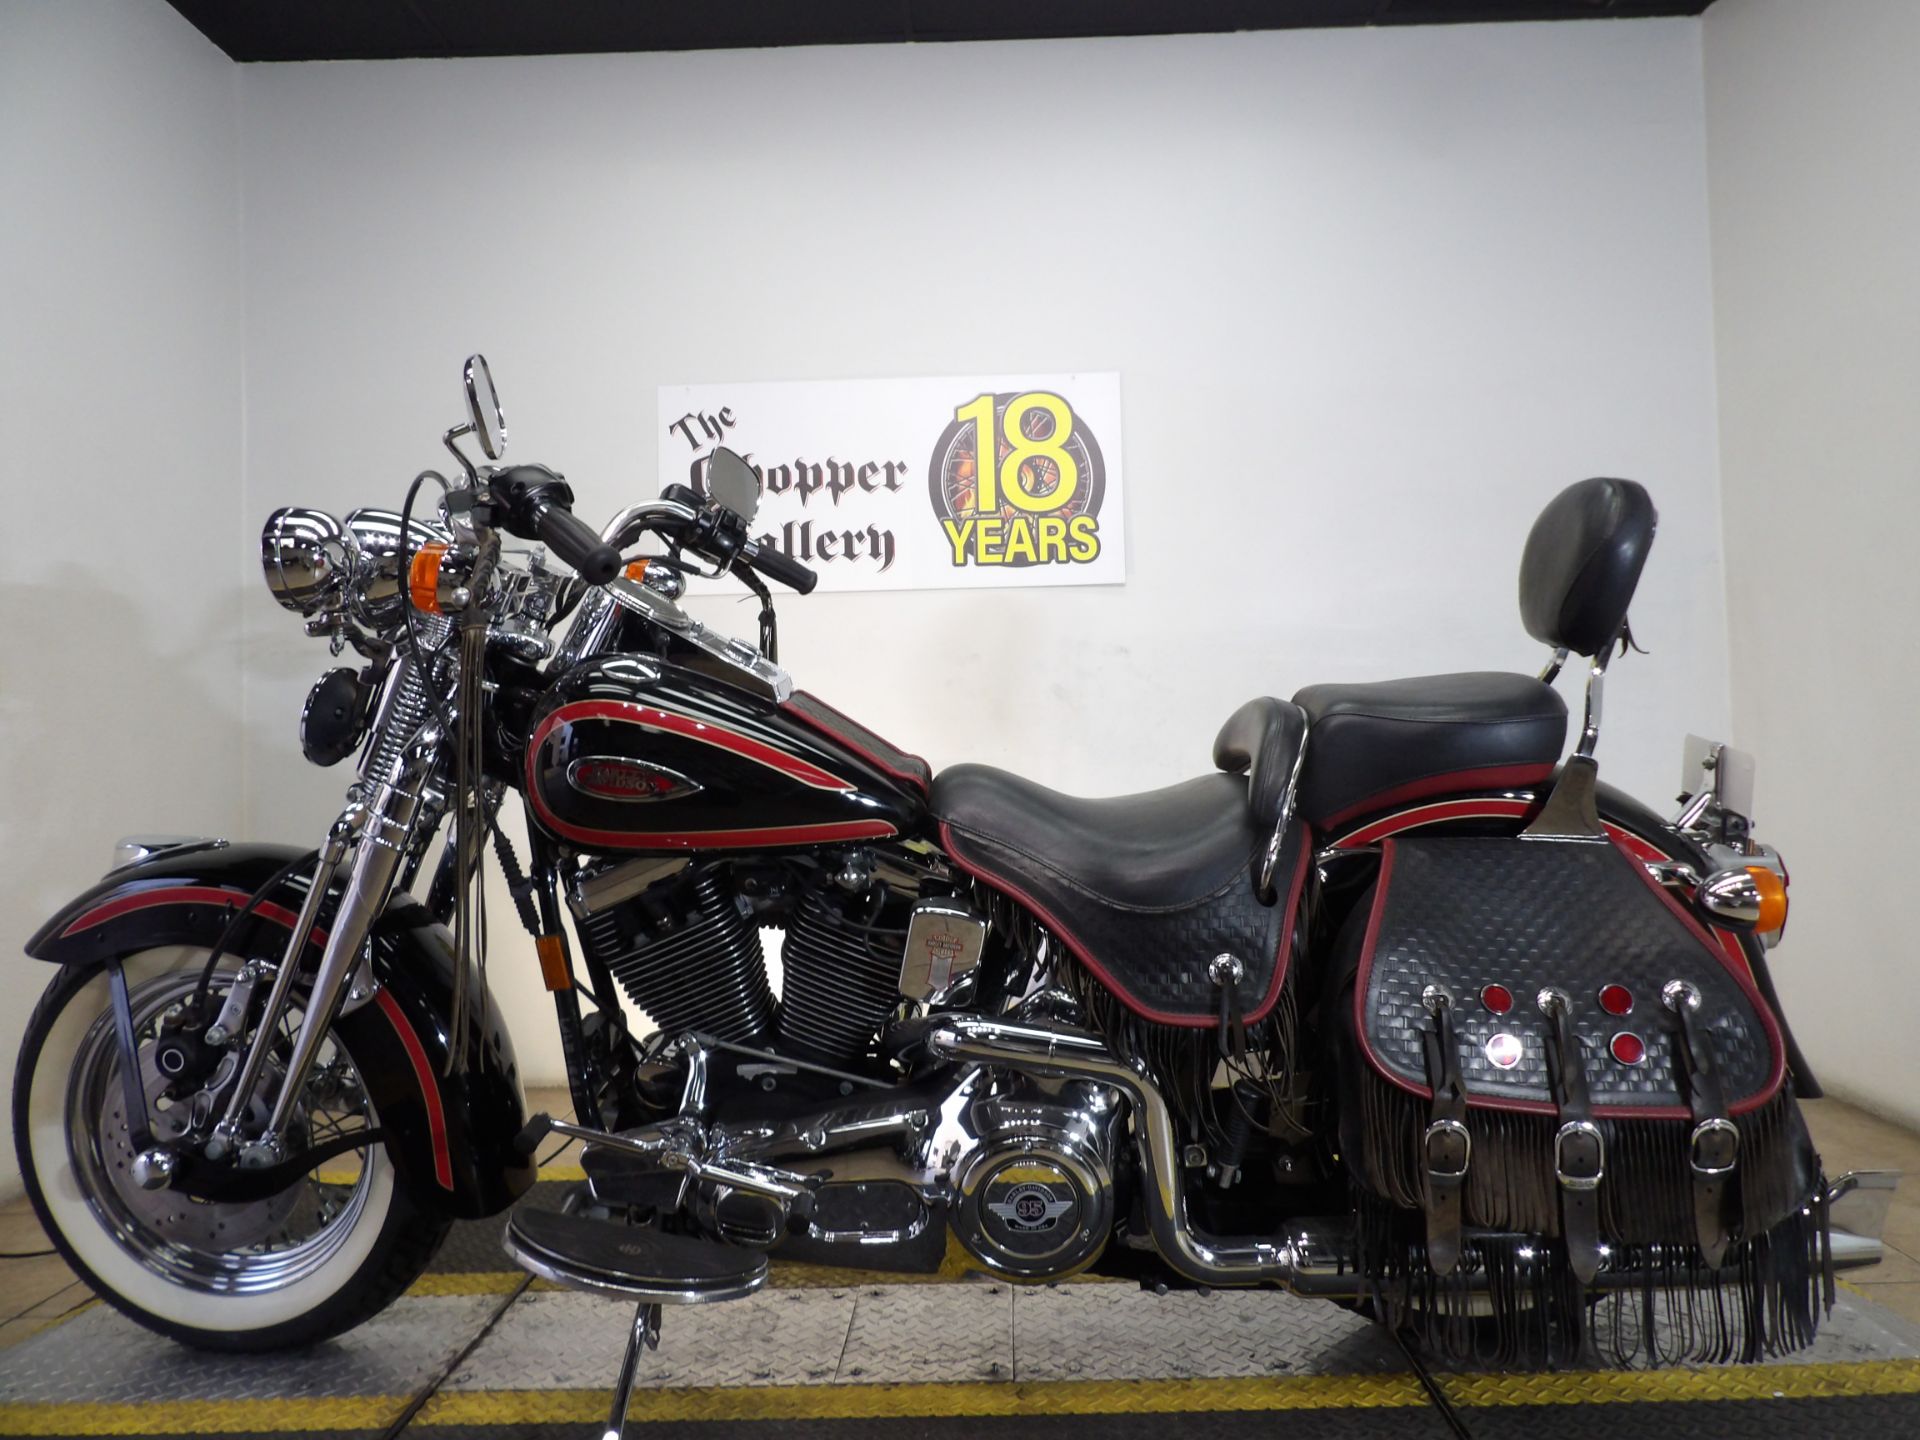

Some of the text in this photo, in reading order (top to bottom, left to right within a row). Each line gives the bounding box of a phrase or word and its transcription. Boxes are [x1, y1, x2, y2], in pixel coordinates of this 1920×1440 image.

[669, 406, 736, 451] The
[955, 391, 1079, 514] 18
[690, 453, 908, 507] opper
[754, 519, 896, 573] allery
[942, 515, 1099, 565] YEARS
[1017, 1200, 1044, 1217] 95
